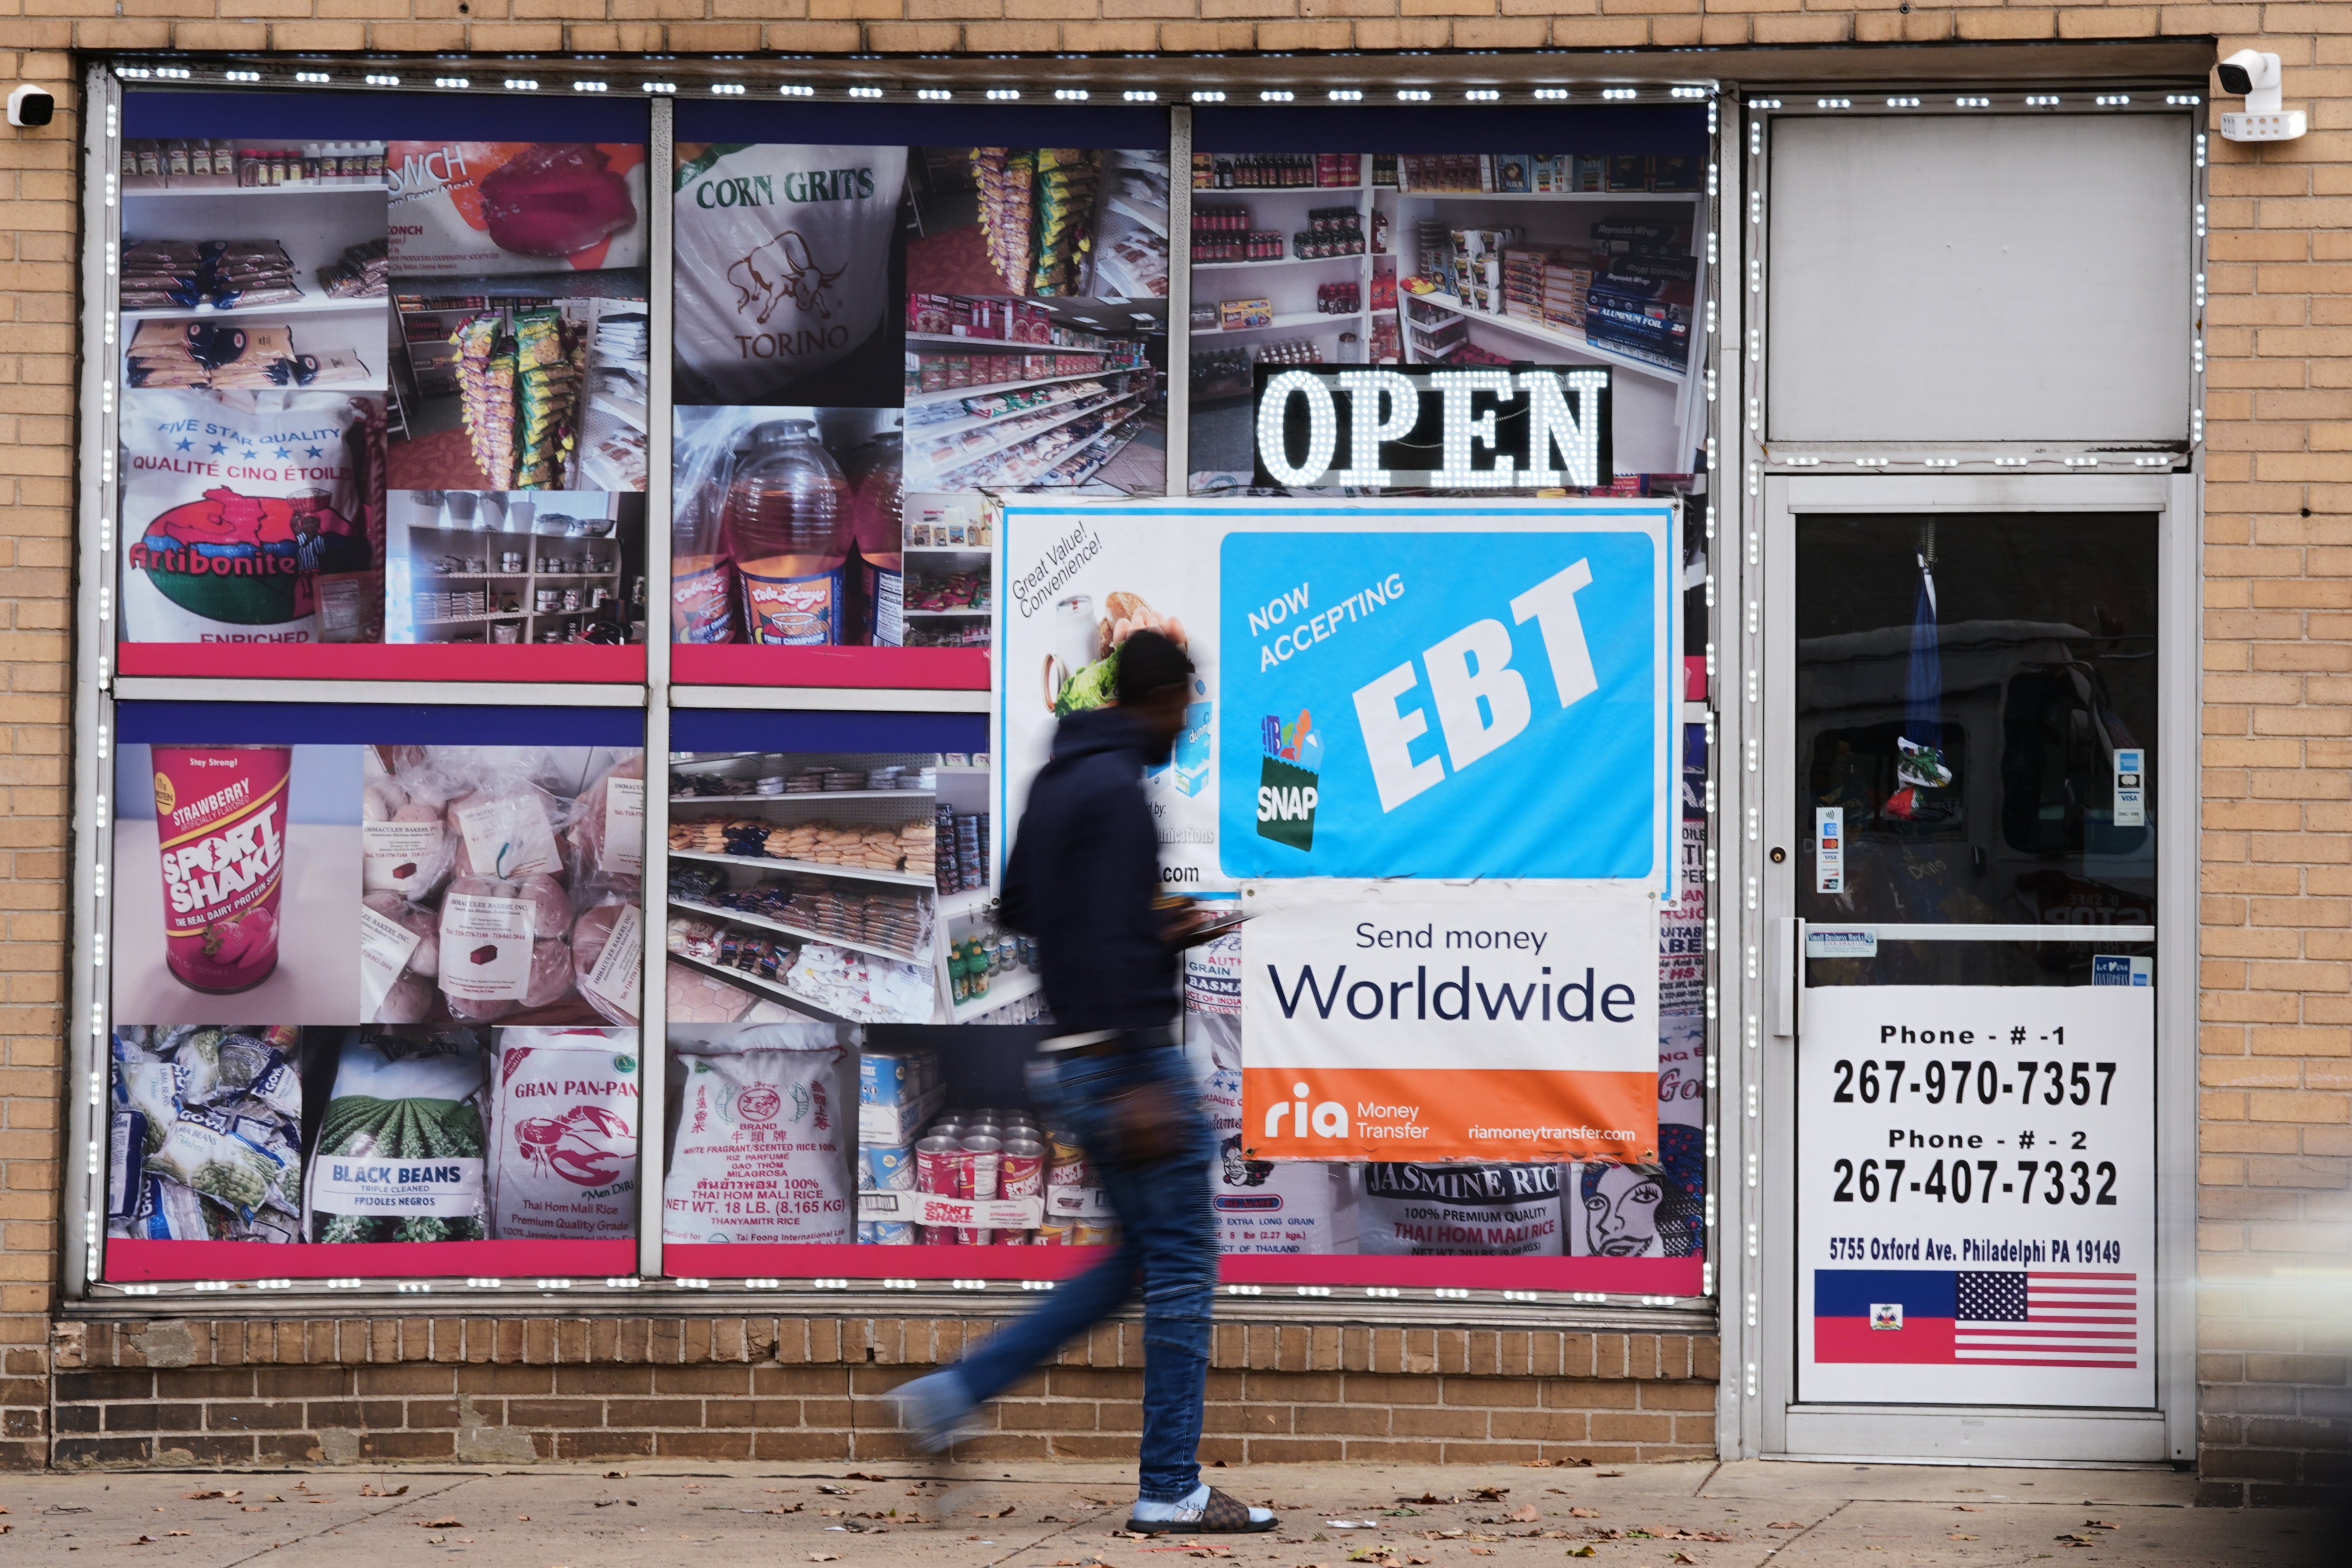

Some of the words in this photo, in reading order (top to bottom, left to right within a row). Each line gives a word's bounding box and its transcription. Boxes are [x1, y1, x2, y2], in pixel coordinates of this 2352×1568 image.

[405, 188, 436, 202] Raw
[439, 177, 475, 194] Meat
[697, 175, 774, 209] CORN
[784, 167, 875, 203] GRITS
[1600, 307, 1642, 324] ALUMINUM
[1643, 316, 1663, 329] FOIL
[735, 325, 848, 359] TORINO
[158, 419, 199, 433] FIVE
[205, 422, 253, 446] STAR
[259, 429, 340, 444] QUALITY
[1257, 370, 1607, 487] OPEN
[133, 459, 219, 477] QUALITÉ
[226, 466, 278, 482] CINQ
[129, 542, 296, 576] Artibonite
[1011, 559, 1048, 601] Great
[1046, 521, 1087, 567] Value!
[1019, 532, 1103, 619] Convenience!
[1247, 582, 1310, 637] NOW
[1260, 573, 1406, 673] ACCEPTING
[200, 630, 309, 643] ENRICHED
[1351, 556, 1599, 814] EBT
[190, 758, 206, 768] Stay
[208, 758, 238, 768] Strong!
[172, 777, 249, 826] STRAWBERRY
[218, 795, 250, 817] FLAVORED
[1256, 786, 1319, 822] SNAP
[162, 800, 278, 885] SPORT
[169, 830, 282, 913] SHAKE
[187, 914, 207, 927] REAL
[207, 904, 232, 920] DAIRY
[234, 883, 266, 909] PROTEIN
[1356, 922, 1433, 948] Send
[1446, 930, 1548, 956] money
[1824, 933, 1849, 942] Business
[593, 947, 616, 985] IMMACULEE
[1189, 962, 1231, 976] GRAIN
[1217, 996, 1241, 1005] INDIA
[1267, 964, 1636, 1023] Worldwide
[1879, 1025, 1975, 1045] Phone
[2010, 1026, 2027, 1046] #
[265, 1068, 285, 1092] GOYA
[515, 1081, 558, 1098] GRAN
[1833, 1059, 2117, 1106] 267-970-7357
[161, 1086, 170, 1107] BEANS
[1265, 1081, 1349, 1138] ria
[1357, 1101, 1419, 1123] Money
[179, 1110, 226, 1136] GOYA
[1356, 1121, 1429, 1140] Transfer
[1468, 1123, 1636, 1143] riamoneytransfer.com
[192, 1130, 219, 1146] BEANS
[707, 1143, 794, 1154] FRAGRANT/SCENTED
[796, 1143, 816, 1151] RICE
[1888, 1129, 1984, 1149] Phone
[2018, 1130, 2036, 1150] #
[2070, 1131, 2088, 1150] 2
[333, 1165, 392, 1184] BLACK
[398, 1166, 460, 1184] BEANS
[726, 1170, 788, 1178] MILAGROSA
[784, 1179, 819, 1189] 100%
[1370, 1162, 1506, 1198] JASMINE
[1833, 1159, 2117, 1206] 267-407-7332
[391, 1185, 430, 1193] CLEANED
[691, 1190, 720, 1199] THAI
[723, 1190, 753, 1200] HOM
[757, 1190, 789, 1200] MALI
[794, 1190, 824, 1199] RICE
[398, 1197, 435, 1206] NEGROS
[523, 1200, 542, 1211] Thai
[545, 1202, 569, 1212] Hom
[571, 1203, 593, 1214] Mali
[596, 1204, 619, 1214] Rice
[665, 1198, 688, 1212] NET
[692, 1201, 718, 1214] WT.
[725, 1202, 741, 1214] 18
[746, 1202, 770, 1214] LB.
[775, 1201, 819, 1216] (8.165
[823, 1198, 846, 1213] KG)
[924, 1201, 975, 1220] SPORT
[512, 1214, 554, 1228] Premium
[556, 1218, 595, 1232] Quality
[597, 1220, 629, 1231] Grade
[710, 1217, 774, 1225] THANYAMITR
[1227, 1218, 1254, 1226] EXTRA
[1287, 1218, 1315, 1226] GRAIN
[1404, 1207, 1440, 1220] 100%
[1443, 1209, 1502, 1222] PREMIUM
[1504, 1206, 1547, 1223] QUALITY
[502, 1226, 524, 1237] 100%
[689, 1231, 702, 1240] for
[751, 1234, 778, 1243] Foong
[780, 1231, 833, 1241] International
[1260, 1231, 1281, 1240] (2.27
[1285, 1231, 1306, 1240] kgs.)
[1394, 1222, 1433, 1242] THAI
[1437, 1226, 1484, 1243] HOM
[1487, 1225, 1529, 1244] MALI
[1531, 1219, 1555, 1238] RICE
[1256, 1244, 1300, 1253] THAILAND
[1829, 1237, 1865, 1261] 5755
[1870, 1237, 1920, 1261] Oxford
[1925, 1238, 1957, 1261] Ave.
[1962, 1238, 2046, 1267] Philadelphi
[2051, 1239, 2071, 1263] PA
[2076, 1239, 2120, 1264] 19149
